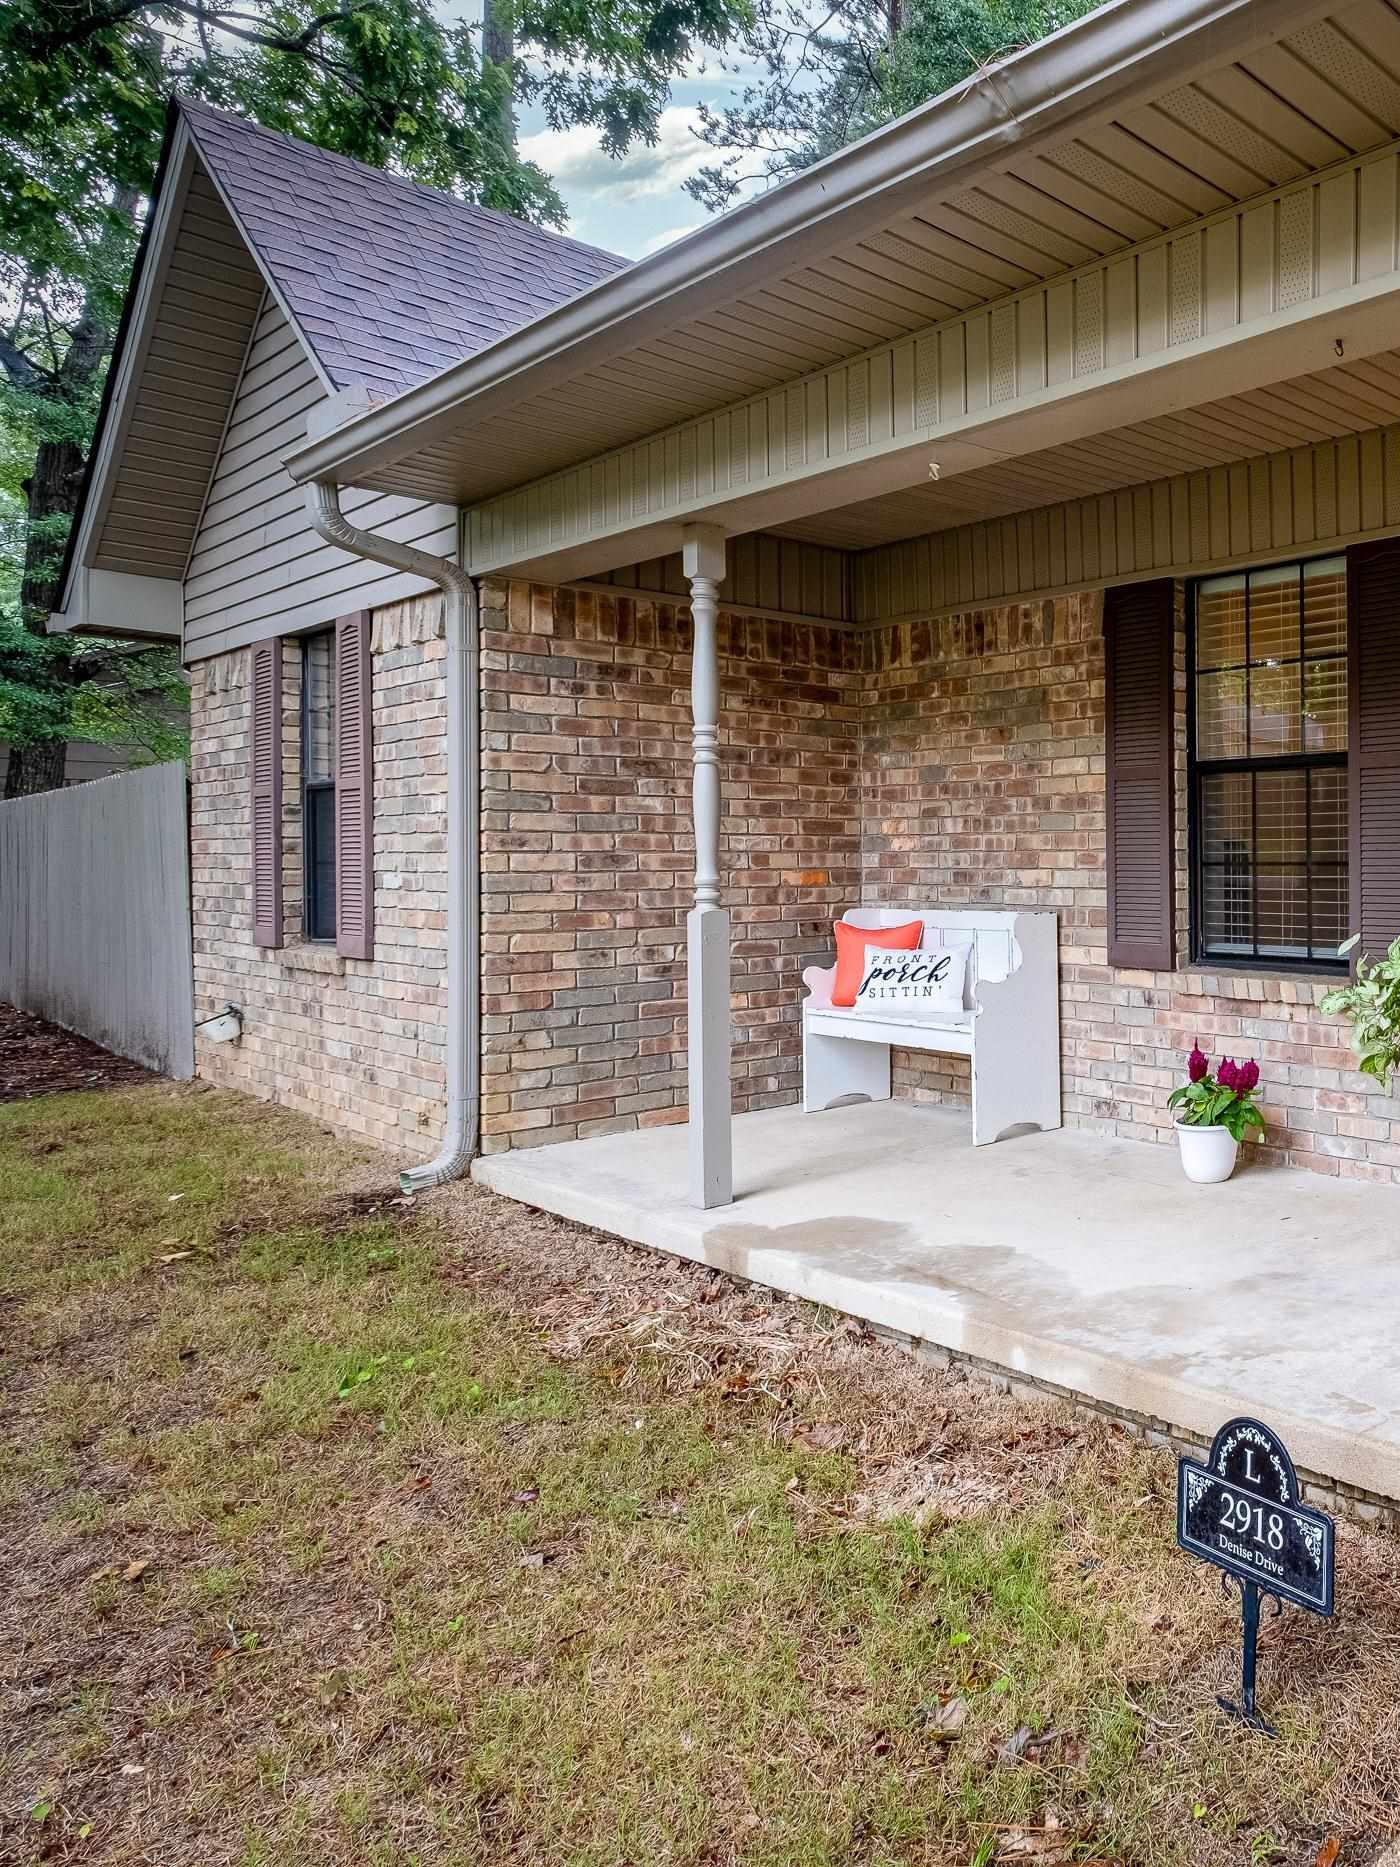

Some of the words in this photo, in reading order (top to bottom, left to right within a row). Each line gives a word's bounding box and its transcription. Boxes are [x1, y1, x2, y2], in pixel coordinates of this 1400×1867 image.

[858, 956, 951, 996] porch
[871, 954, 937, 965] FRONT
[1244, 1448, 1261, 1484] L
[1219, 1492, 1284, 1550] 2918
[1219, 1533, 1253, 1561] Denise
[1255, 1551, 1284, 1576] Drive
